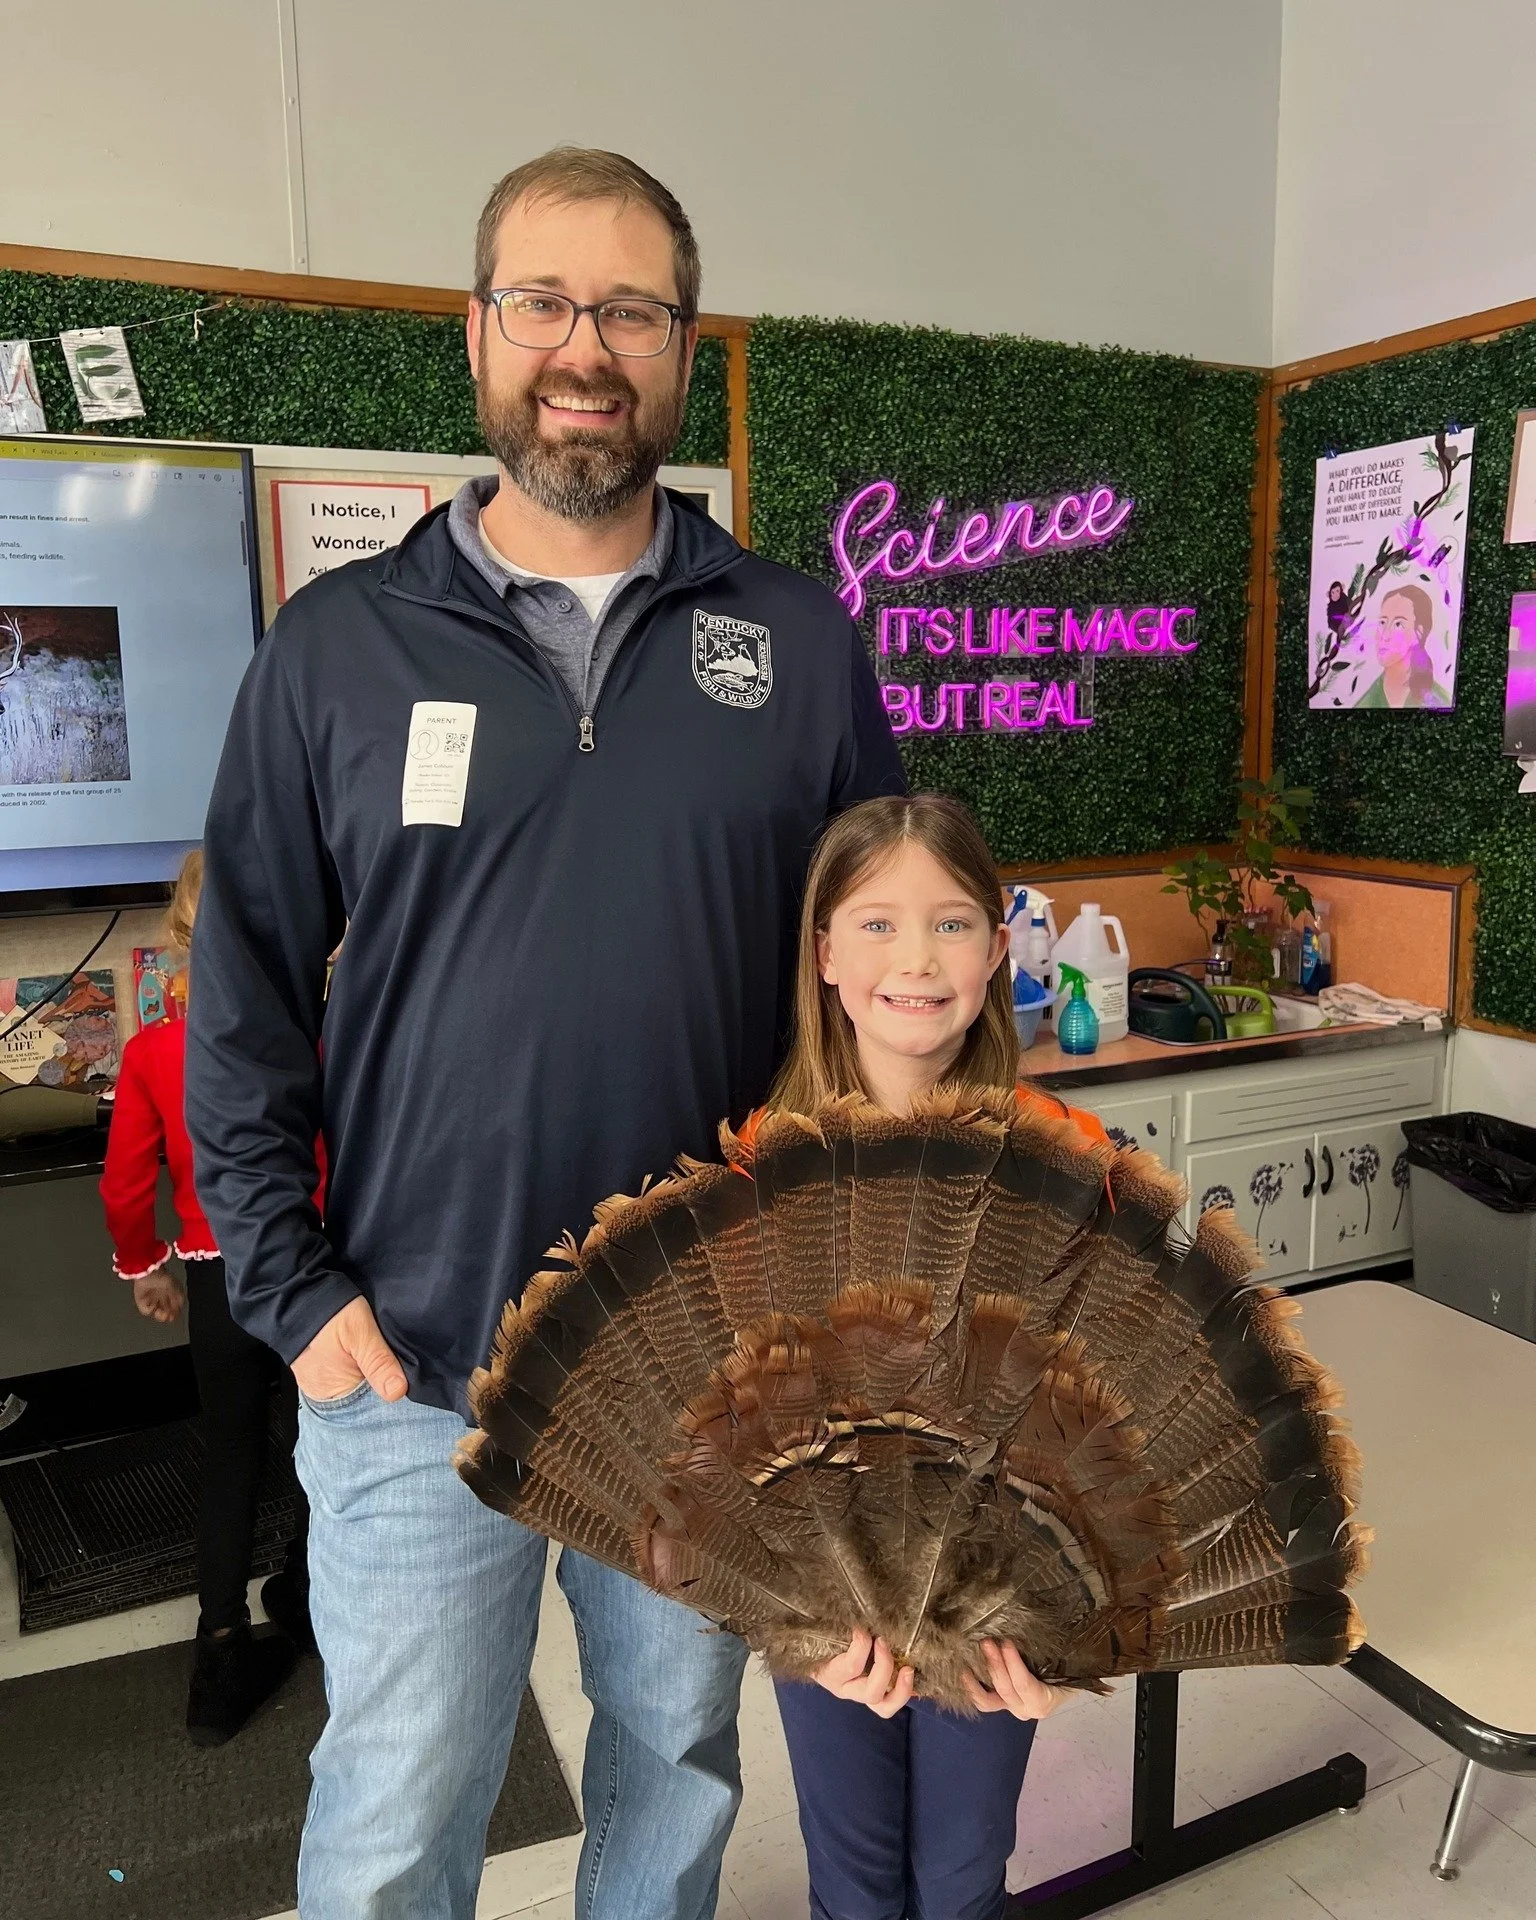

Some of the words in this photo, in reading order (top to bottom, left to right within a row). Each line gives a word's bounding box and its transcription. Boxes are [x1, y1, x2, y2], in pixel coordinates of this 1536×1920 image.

[1329, 469, 1348, 479] WHAT
[1351, 465, 1365, 475] YOU
[1367, 463, 1377, 472] DO
[1380, 458, 1404, 470] MAKES
[1328, 482, 1335, 494] A
[1339, 469, 1403, 492] DIFFERENCE,
[1334, 494, 1346, 503] YOU
[1349, 491, 1366, 501] HAVE
[1369, 489, 1377, 498] TO
[1379, 485, 1402, 496] DECIDE
[1359, 502, 1366, 510] OF
[1368, 497, 1402, 509] DIFFERENCE
[311, 503, 316, 517] I
[322, 503, 386, 521] Notice,
[391, 505, 396, 518] I
[1326, 517, 1340, 526] YOU
[1342, 512, 1364, 523] WANT
[1367, 510, 1377, 520] TO
[9, 553, 37, 561] feeding
[829, 478, 1135, 619] Science
[699, 615, 764, 638] KENTUCKY
[881, 608, 956, 655] IT'S
[965, 607, 1057, 655] LIKE
[1064, 607, 1198, 654] MAGIC
[699, 671, 719, 693] FISH
[719, 690, 727, 699] &
[728, 684, 767, 704] WILDLIFE
[881, 682, 976, 731] BUT
[984, 681, 1093, 730] REAL
[8, 1041, 34, 1051] LIFE
